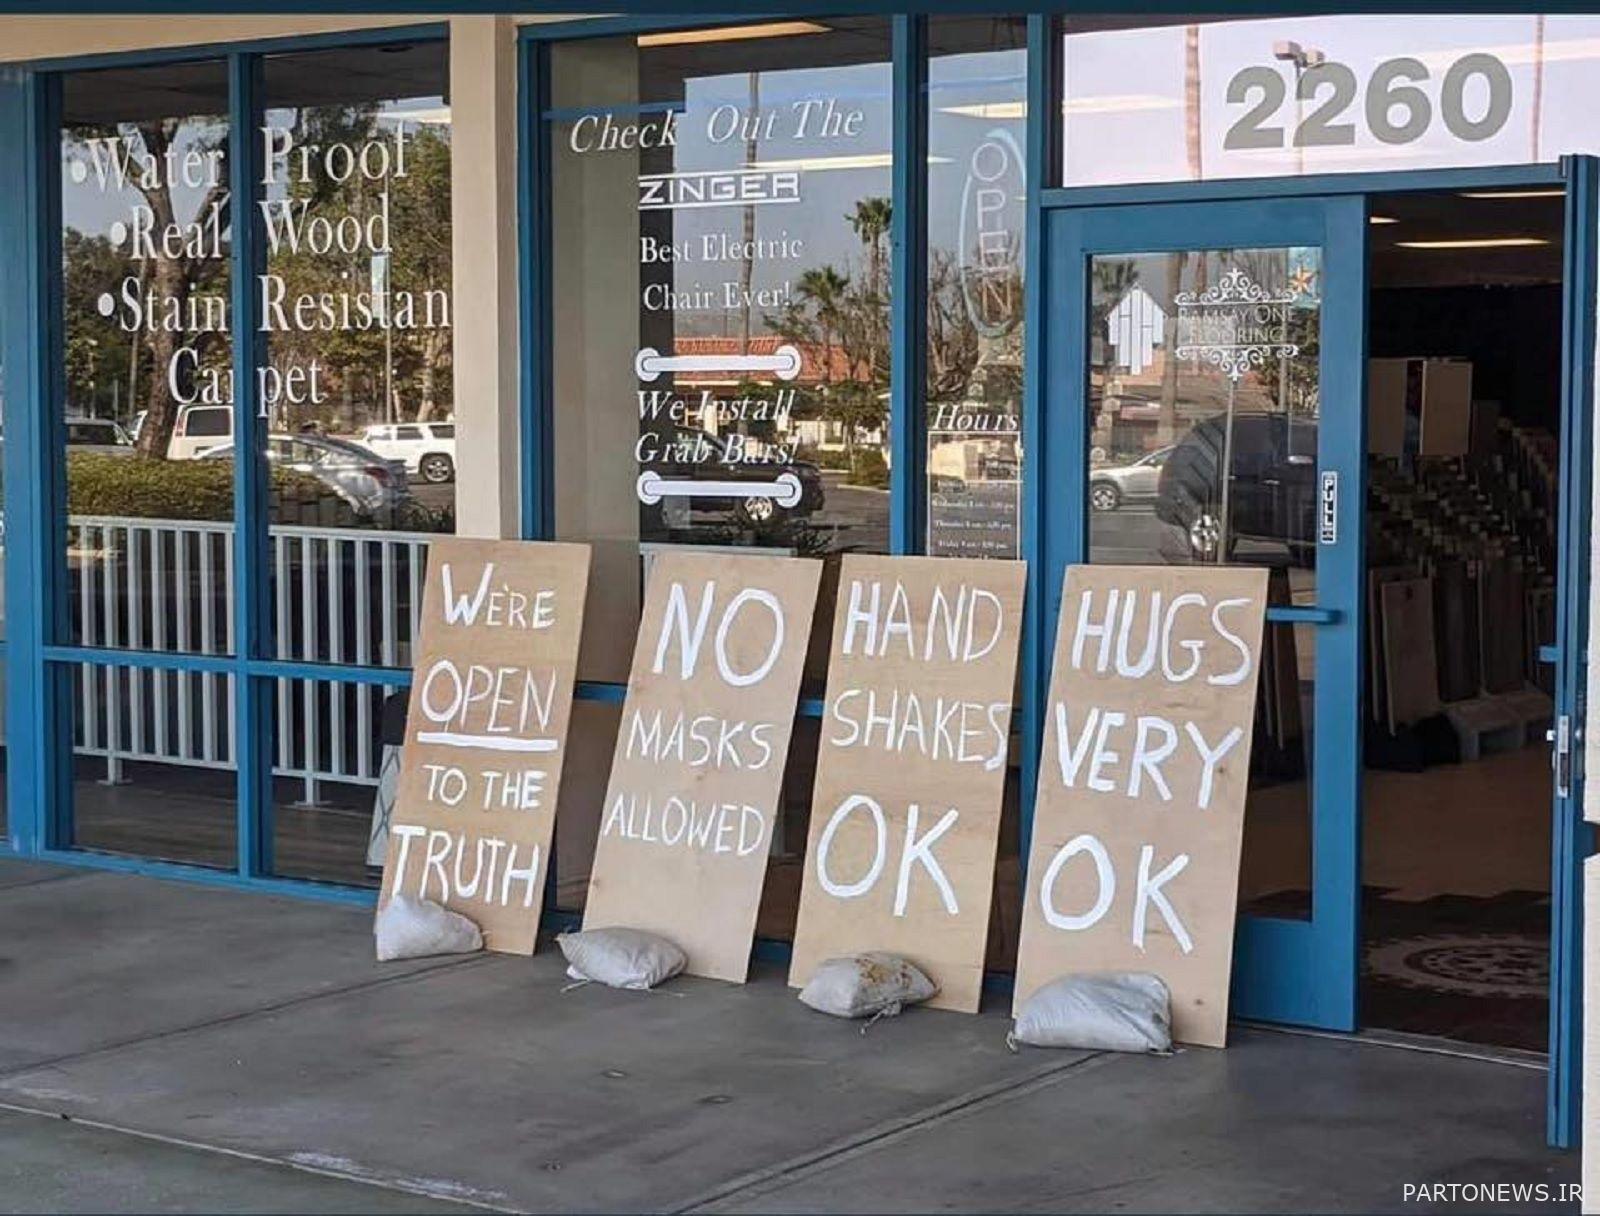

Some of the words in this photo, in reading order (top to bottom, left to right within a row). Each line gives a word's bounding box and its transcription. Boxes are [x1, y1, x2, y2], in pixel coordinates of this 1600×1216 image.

[569, 109, 678, 153] Check
[707, 103, 781, 143] Out
[792, 98, 864, 139] The
[1223, 52, 1513, 150] 2260
[86, 135, 225, 194] Water
[261, 120, 411, 186] Proof
[639, 172, 799, 204] ZINGER
[131, 202, 223, 260] Real
[257, 193, 393, 256] Wood
[640, 236, 690, 263] Best
[702, 231, 803, 262] Electric
[972, 142, 1013, 322] OPEN
[119, 276, 229, 333] Stain
[643, 283, 714, 311] Chair
[722, 281, 791, 309] Ever!
[636, 390, 684, 421] We
[697, 389, 796, 421] Install
[930, 402, 1019, 431] Hours
[634, 432, 710, 463] Grab
[720, 432, 800, 464] Bars!
[1323, 479, 1334, 526] PULL
[652, 580, 785, 687] NO
[842, 580, 1003, 662] HAND
[1071, 589, 1253, 686] HUGS
[421, 659, 556, 734] OPEN
[830, 688, 1013, 771] SHAKES
[625, 708, 774, 770] MASKS
[1055, 702, 1243, 810] VERY
[421, 764, 467, 806] TO
[479, 769, 547, 809] THE
[604, 793, 764, 856] ALLOWED
[816, 794, 960, 917] OK
[391, 825, 540, 907] TRUTH
[1041, 834, 1193, 954] OK
